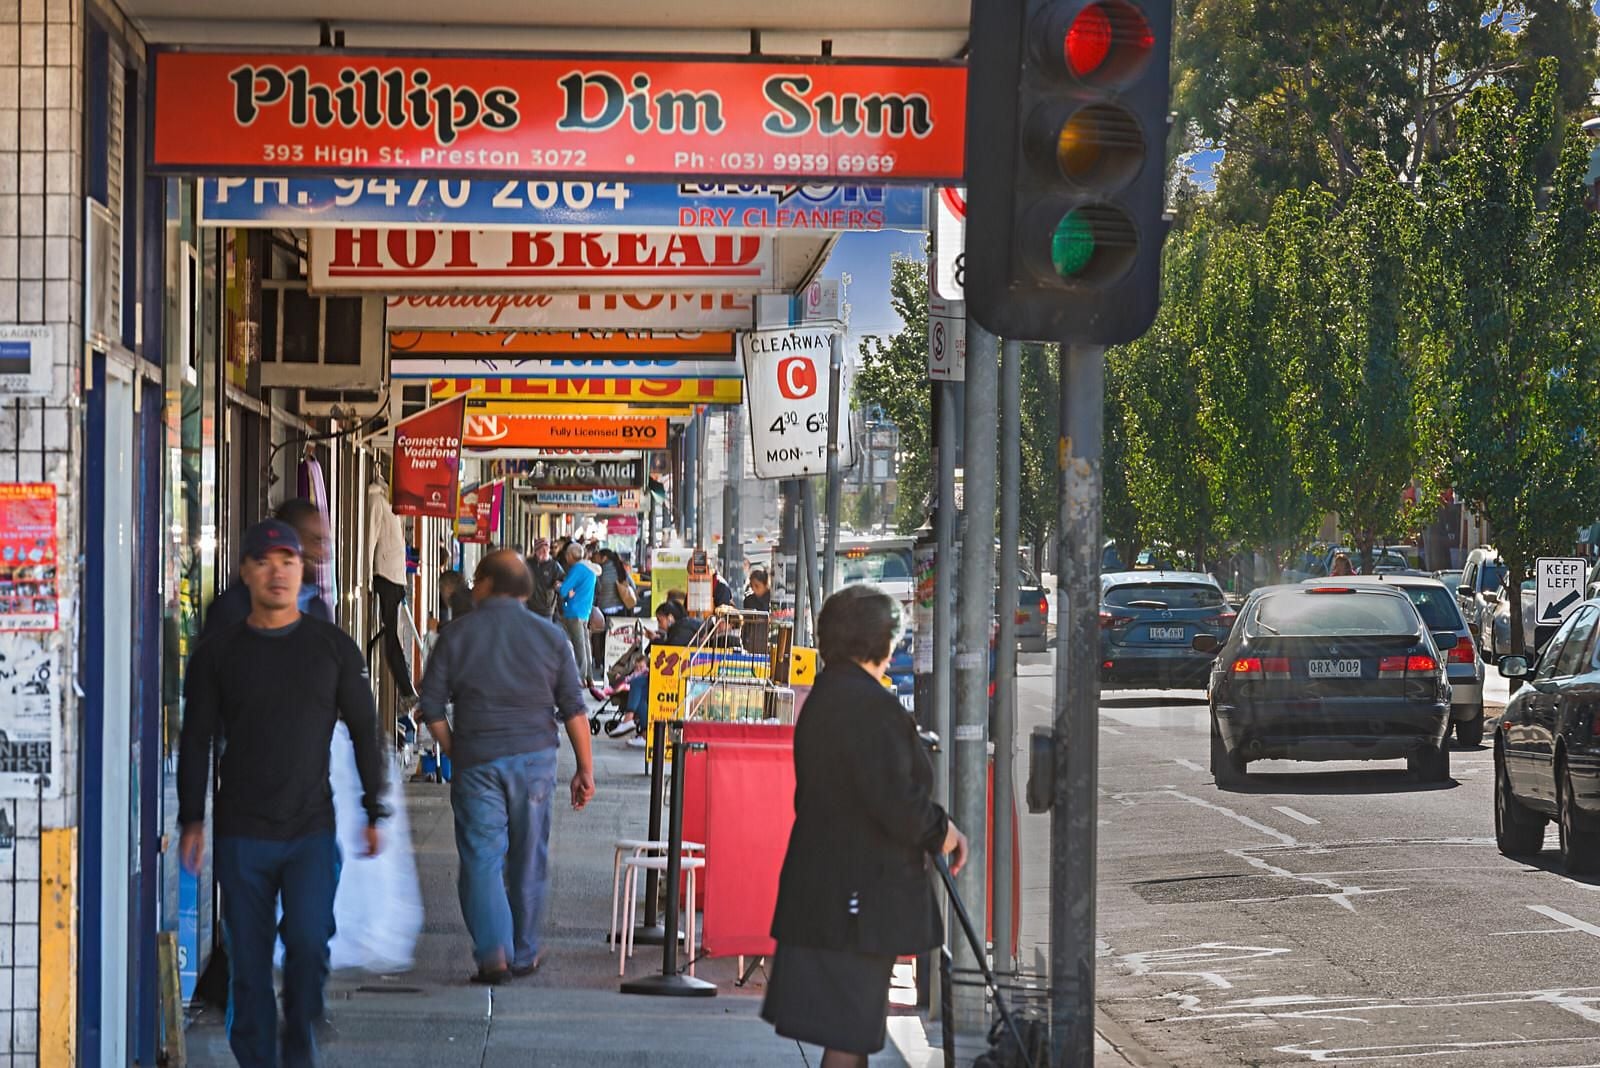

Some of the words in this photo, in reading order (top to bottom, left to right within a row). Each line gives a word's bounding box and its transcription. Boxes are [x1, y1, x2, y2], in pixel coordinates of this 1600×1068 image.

[228, 64, 520, 146] Phillips
[556, 70, 726, 134] Dim
[762, 74, 933, 138] Sum
[262, 144, 304, 161] 393
[314, 145, 368, 164] High
[421, 147, 520, 166] Preston
[531, 149, 587, 166] 3072
[720, 152, 764, 170] (03)
[773, 154, 829, 171] 9939
[837, 155, 894, 173] 6969
[678, 206, 737, 228] DRY
[742, 207, 885, 230] CLEANERS
[328, 228, 478, 269] HOT
[506, 231, 761, 268] BREAD
[750, 333, 832, 354] CLEARWAY
[550, 426, 571, 438] Fully
[574, 426, 619, 438] Licensed
[621, 425, 657, 439] BYO
[397, 435, 445, 447] Connect
[446, 436, 459, 447] to
[403, 446, 457, 458] Vodafone
[411, 457, 438, 469] here
[1546, 564, 1578, 575] KEEP
[1547, 578, 1577, 588] LEFT
